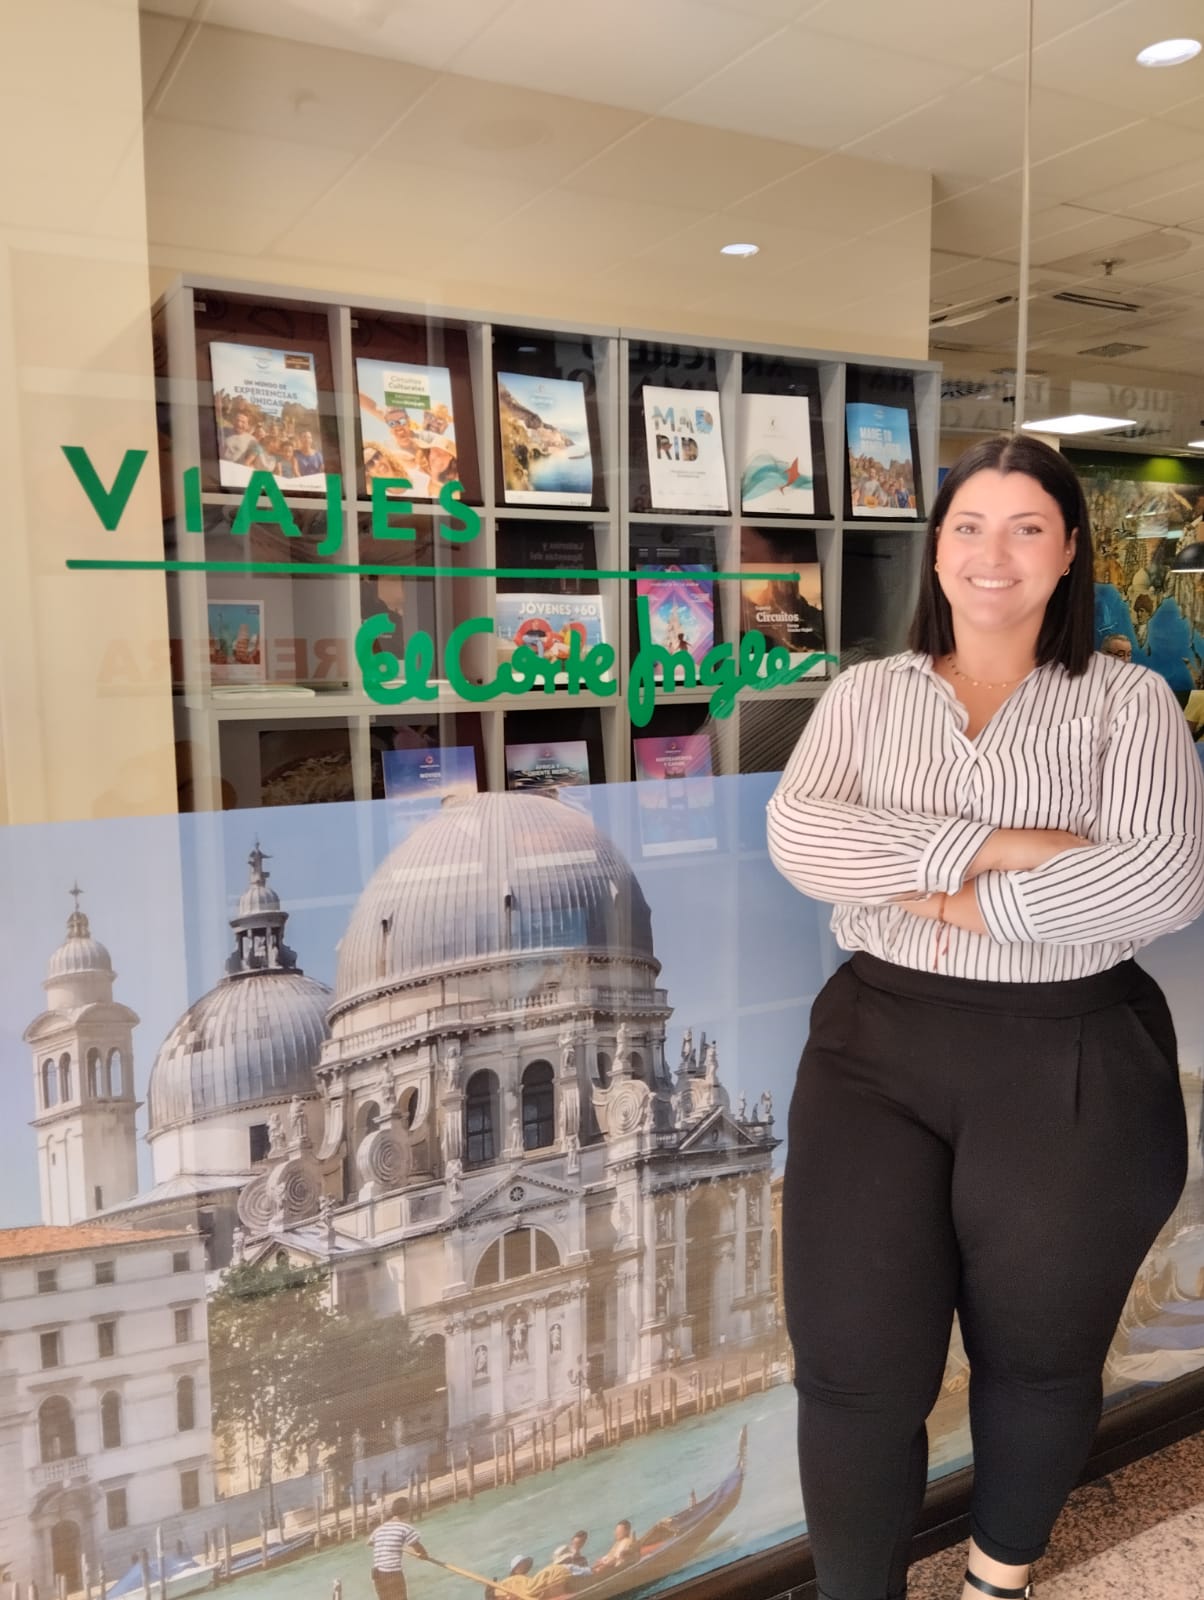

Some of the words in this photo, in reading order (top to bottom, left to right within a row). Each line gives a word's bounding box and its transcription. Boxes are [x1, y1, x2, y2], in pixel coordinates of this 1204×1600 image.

[234, 385, 298, 400] EXPERIENCIAS
[655, 434, 699, 462] RID
[64, 447, 482, 556] VIAJES
[519, 600, 572, 616] JÓVENES
[574, 603, 598, 616] +60
[755, 610, 800, 623] Circuitos
[354, 612, 440, 706] El
[444, 616, 618, 703] Corte
